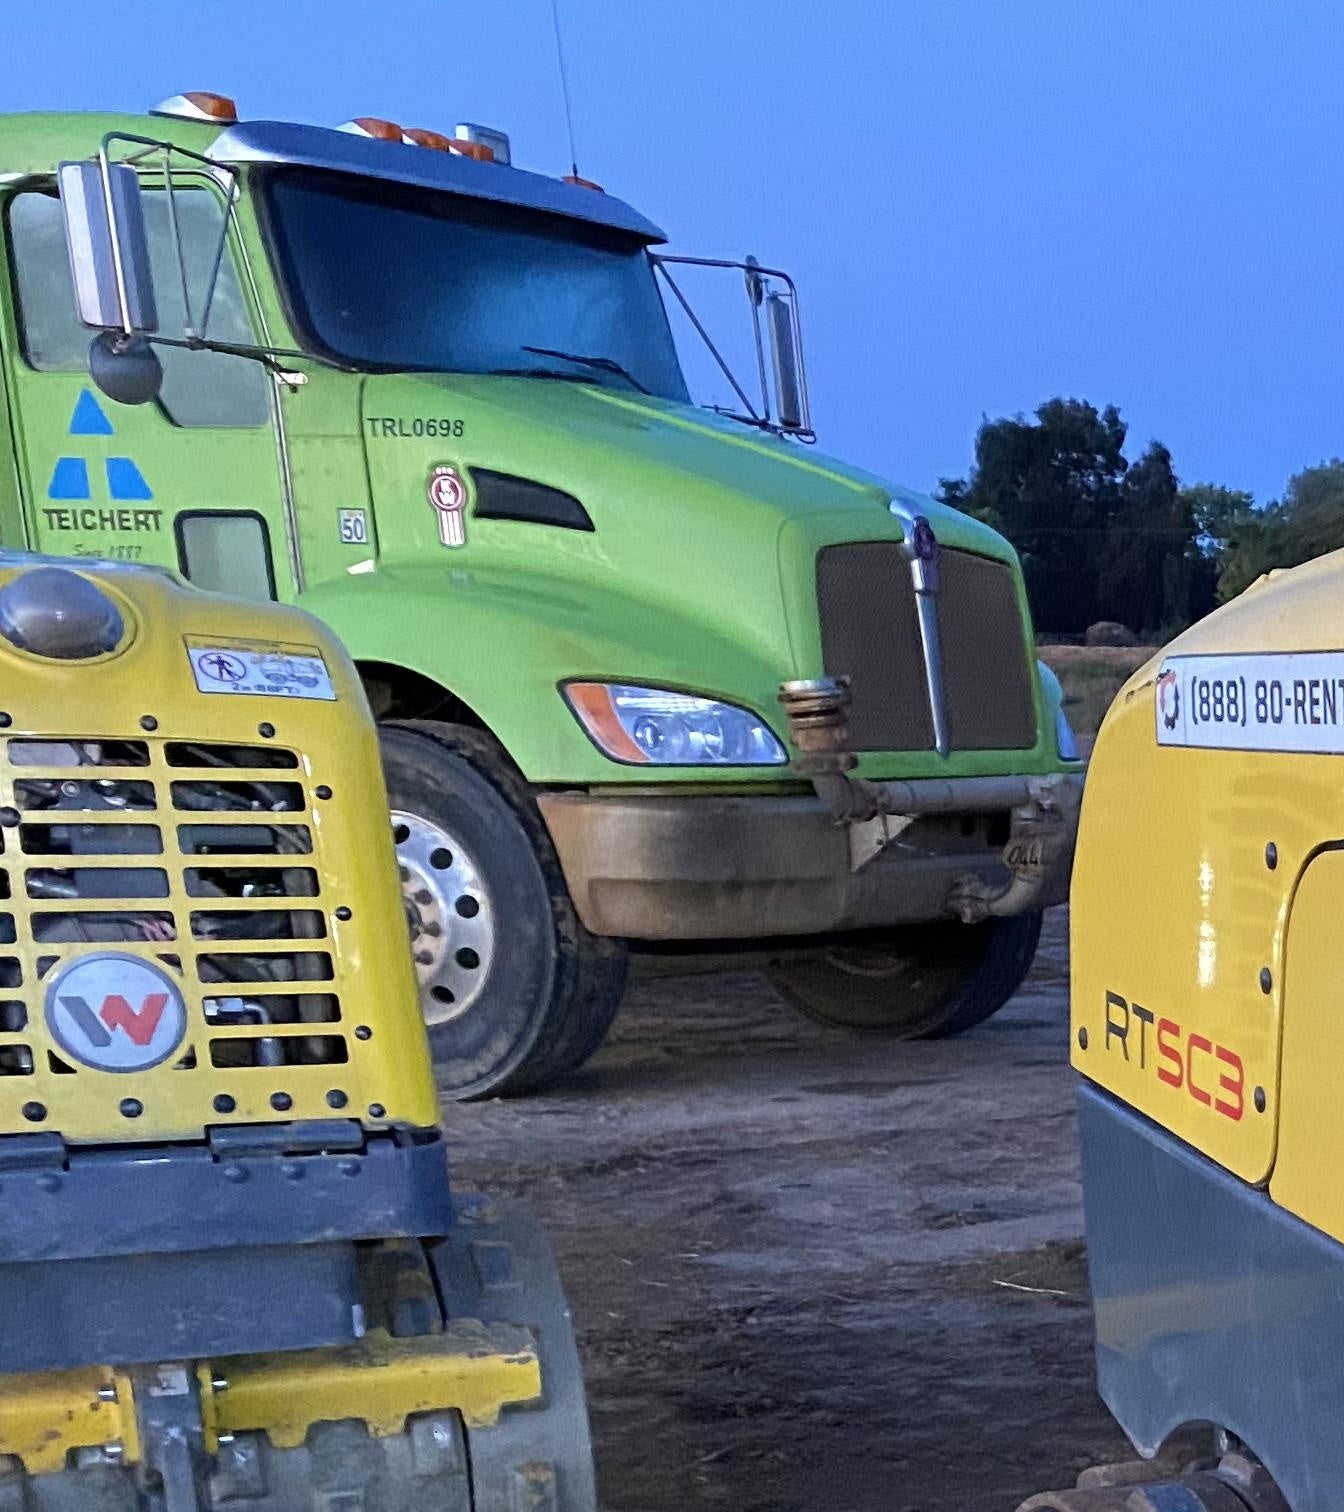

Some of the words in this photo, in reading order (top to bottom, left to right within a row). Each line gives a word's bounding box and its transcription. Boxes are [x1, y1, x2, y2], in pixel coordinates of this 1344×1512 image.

[366, 417, 465, 438] TRL0698
[42, 507, 163, 532] TEICHERT
[341, 517, 364, 541] 50
[1191, 675, 1247, 728] (888)
